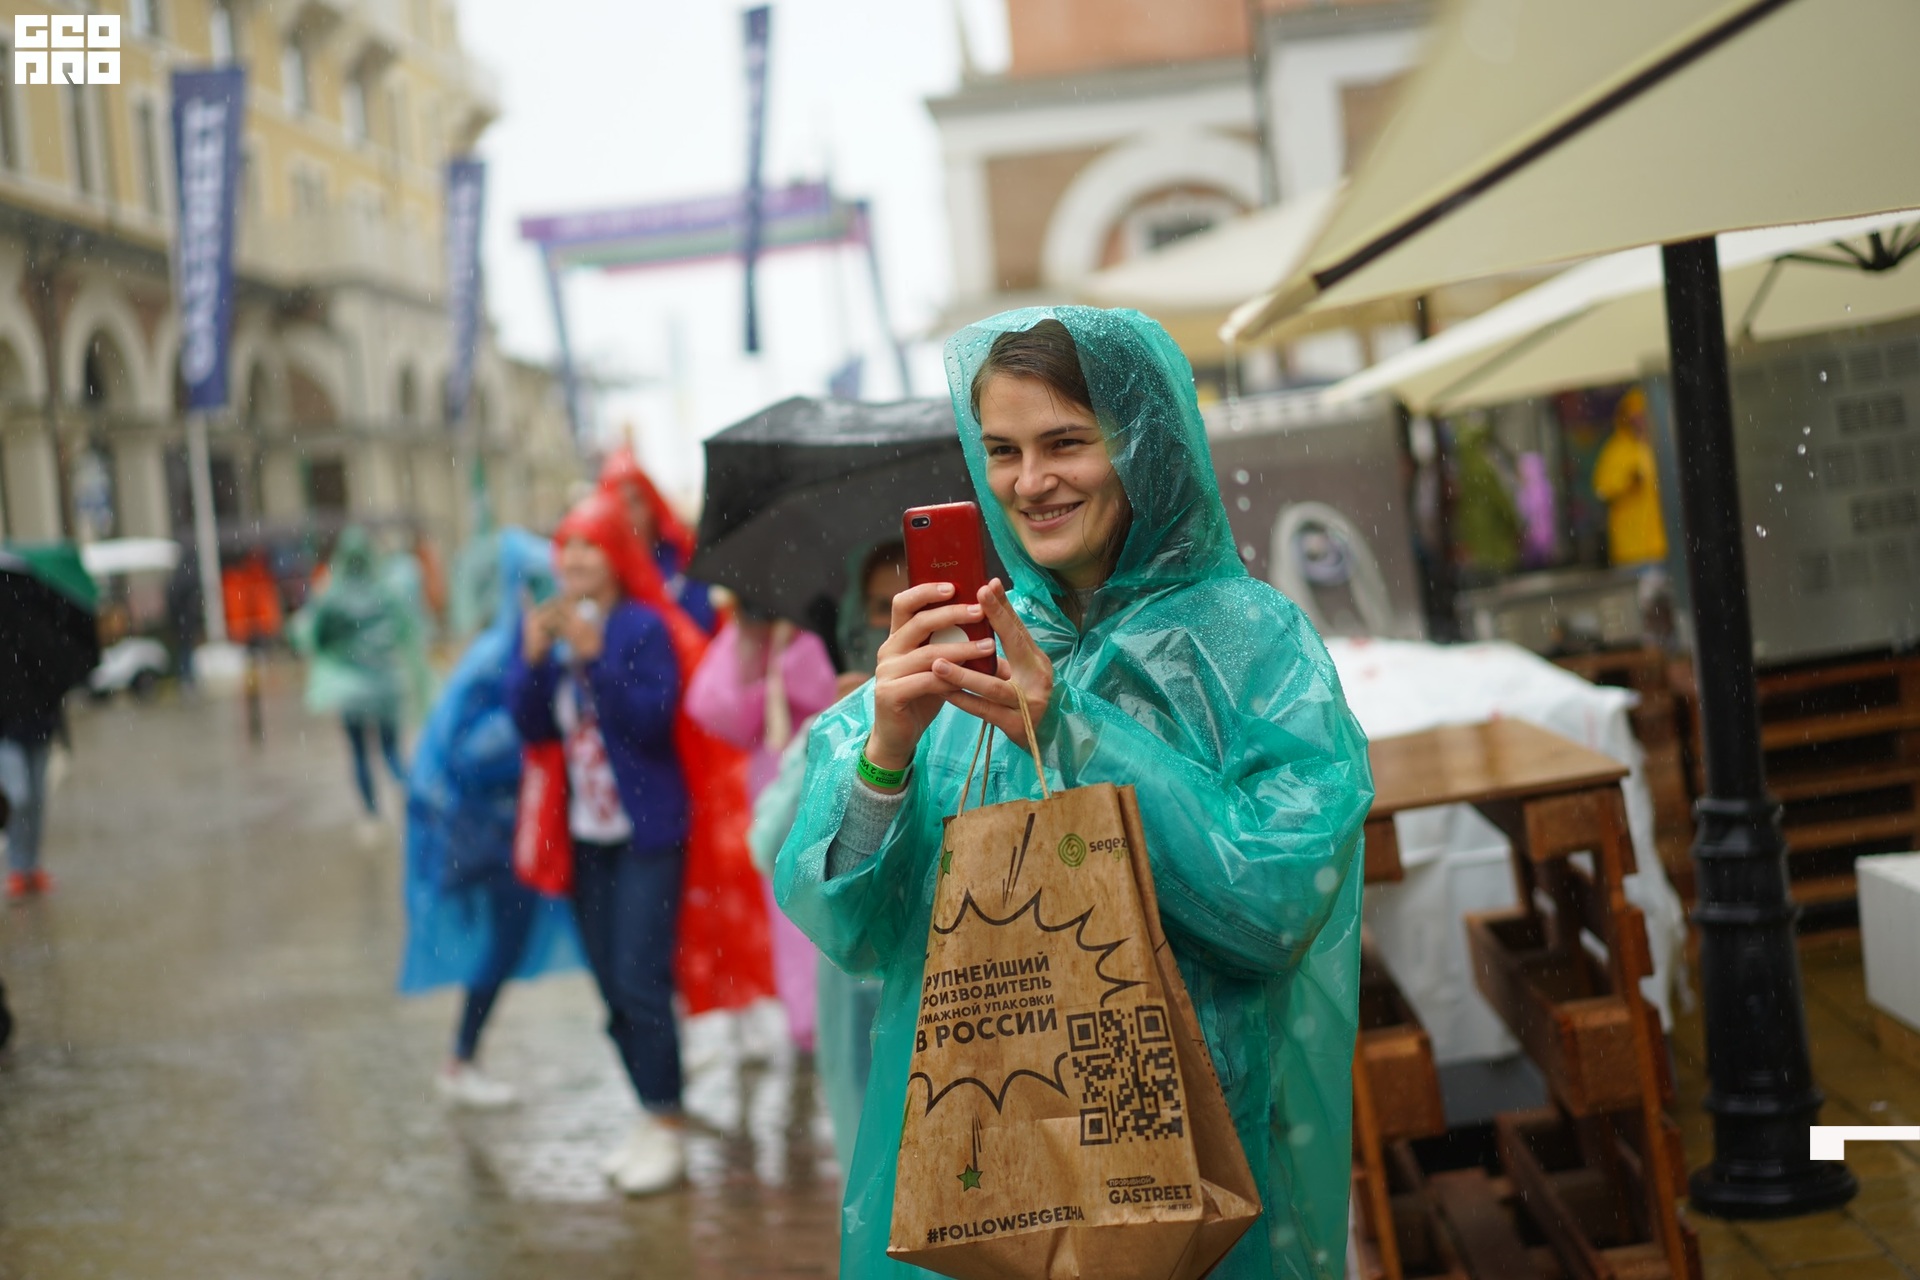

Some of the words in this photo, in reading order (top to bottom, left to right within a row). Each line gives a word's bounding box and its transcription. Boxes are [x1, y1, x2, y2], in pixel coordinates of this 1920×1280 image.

[922, 951, 1050, 993] РУПНЕЙШИЙ
[920, 976, 1052, 1010] РОИЗВОДИТЕЛЬ
[984, 994, 1055, 1014] УПАКОВКИ
[916, 1030, 928, 1053] В
[935, 1008, 1058, 1048] РОССИИ
[1109, 1184, 1192, 1205] GASTREET
[926, 1206, 1085, 1244] #FOLLOWSEGEZHA
